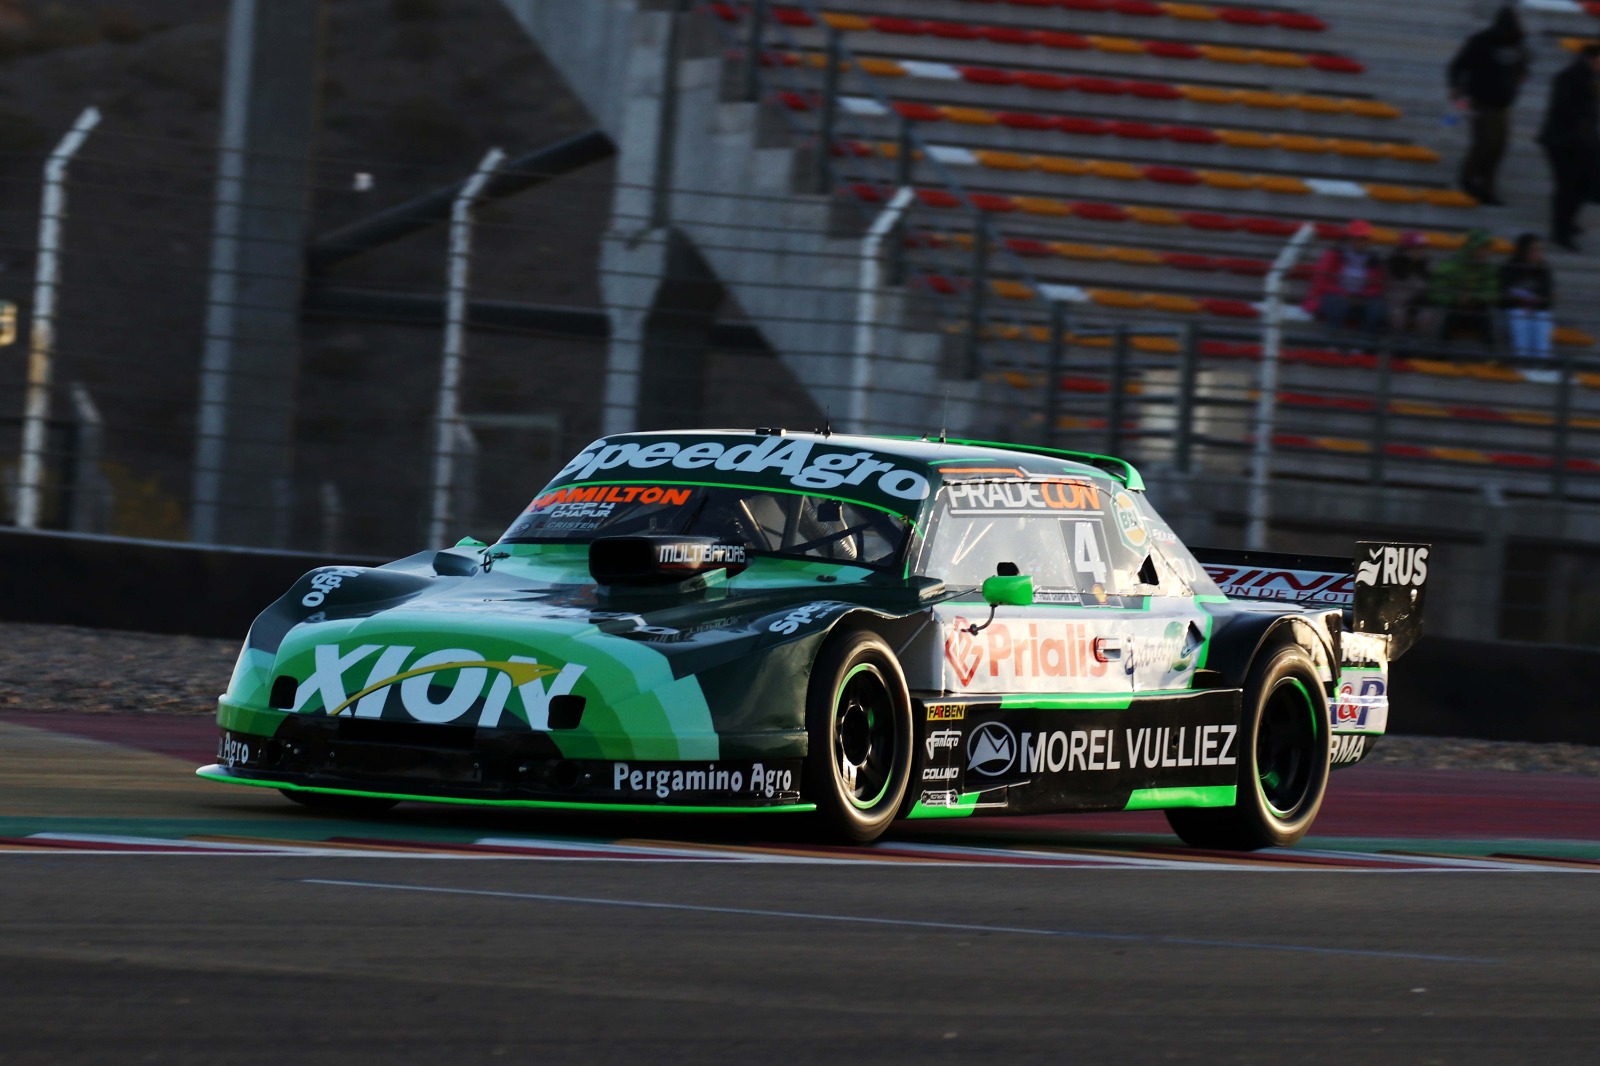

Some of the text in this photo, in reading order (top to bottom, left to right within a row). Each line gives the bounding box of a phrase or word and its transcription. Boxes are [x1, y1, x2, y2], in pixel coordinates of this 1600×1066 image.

[559, 436, 931, 500] SpeedAgro
[528, 486, 692, 511] HAMILTON
[947, 479, 1101, 510] PRADECON
[551, 510, 611, 518] CHAPUR
[1073, 521, 1107, 584] 4
[1383, 546, 1430, 586] RUS
[1258, 587, 1290, 600] DE
[1296, 590, 1355, 603] FLOT
[987, 622, 1109, 677] Prialis
[291, 644, 588, 731] XION
[928, 705, 964, 719] FARBEN
[1021, 725, 1238, 774] MOREL VULLIEZ
[613, 762, 792, 798] Pergamino Agro
